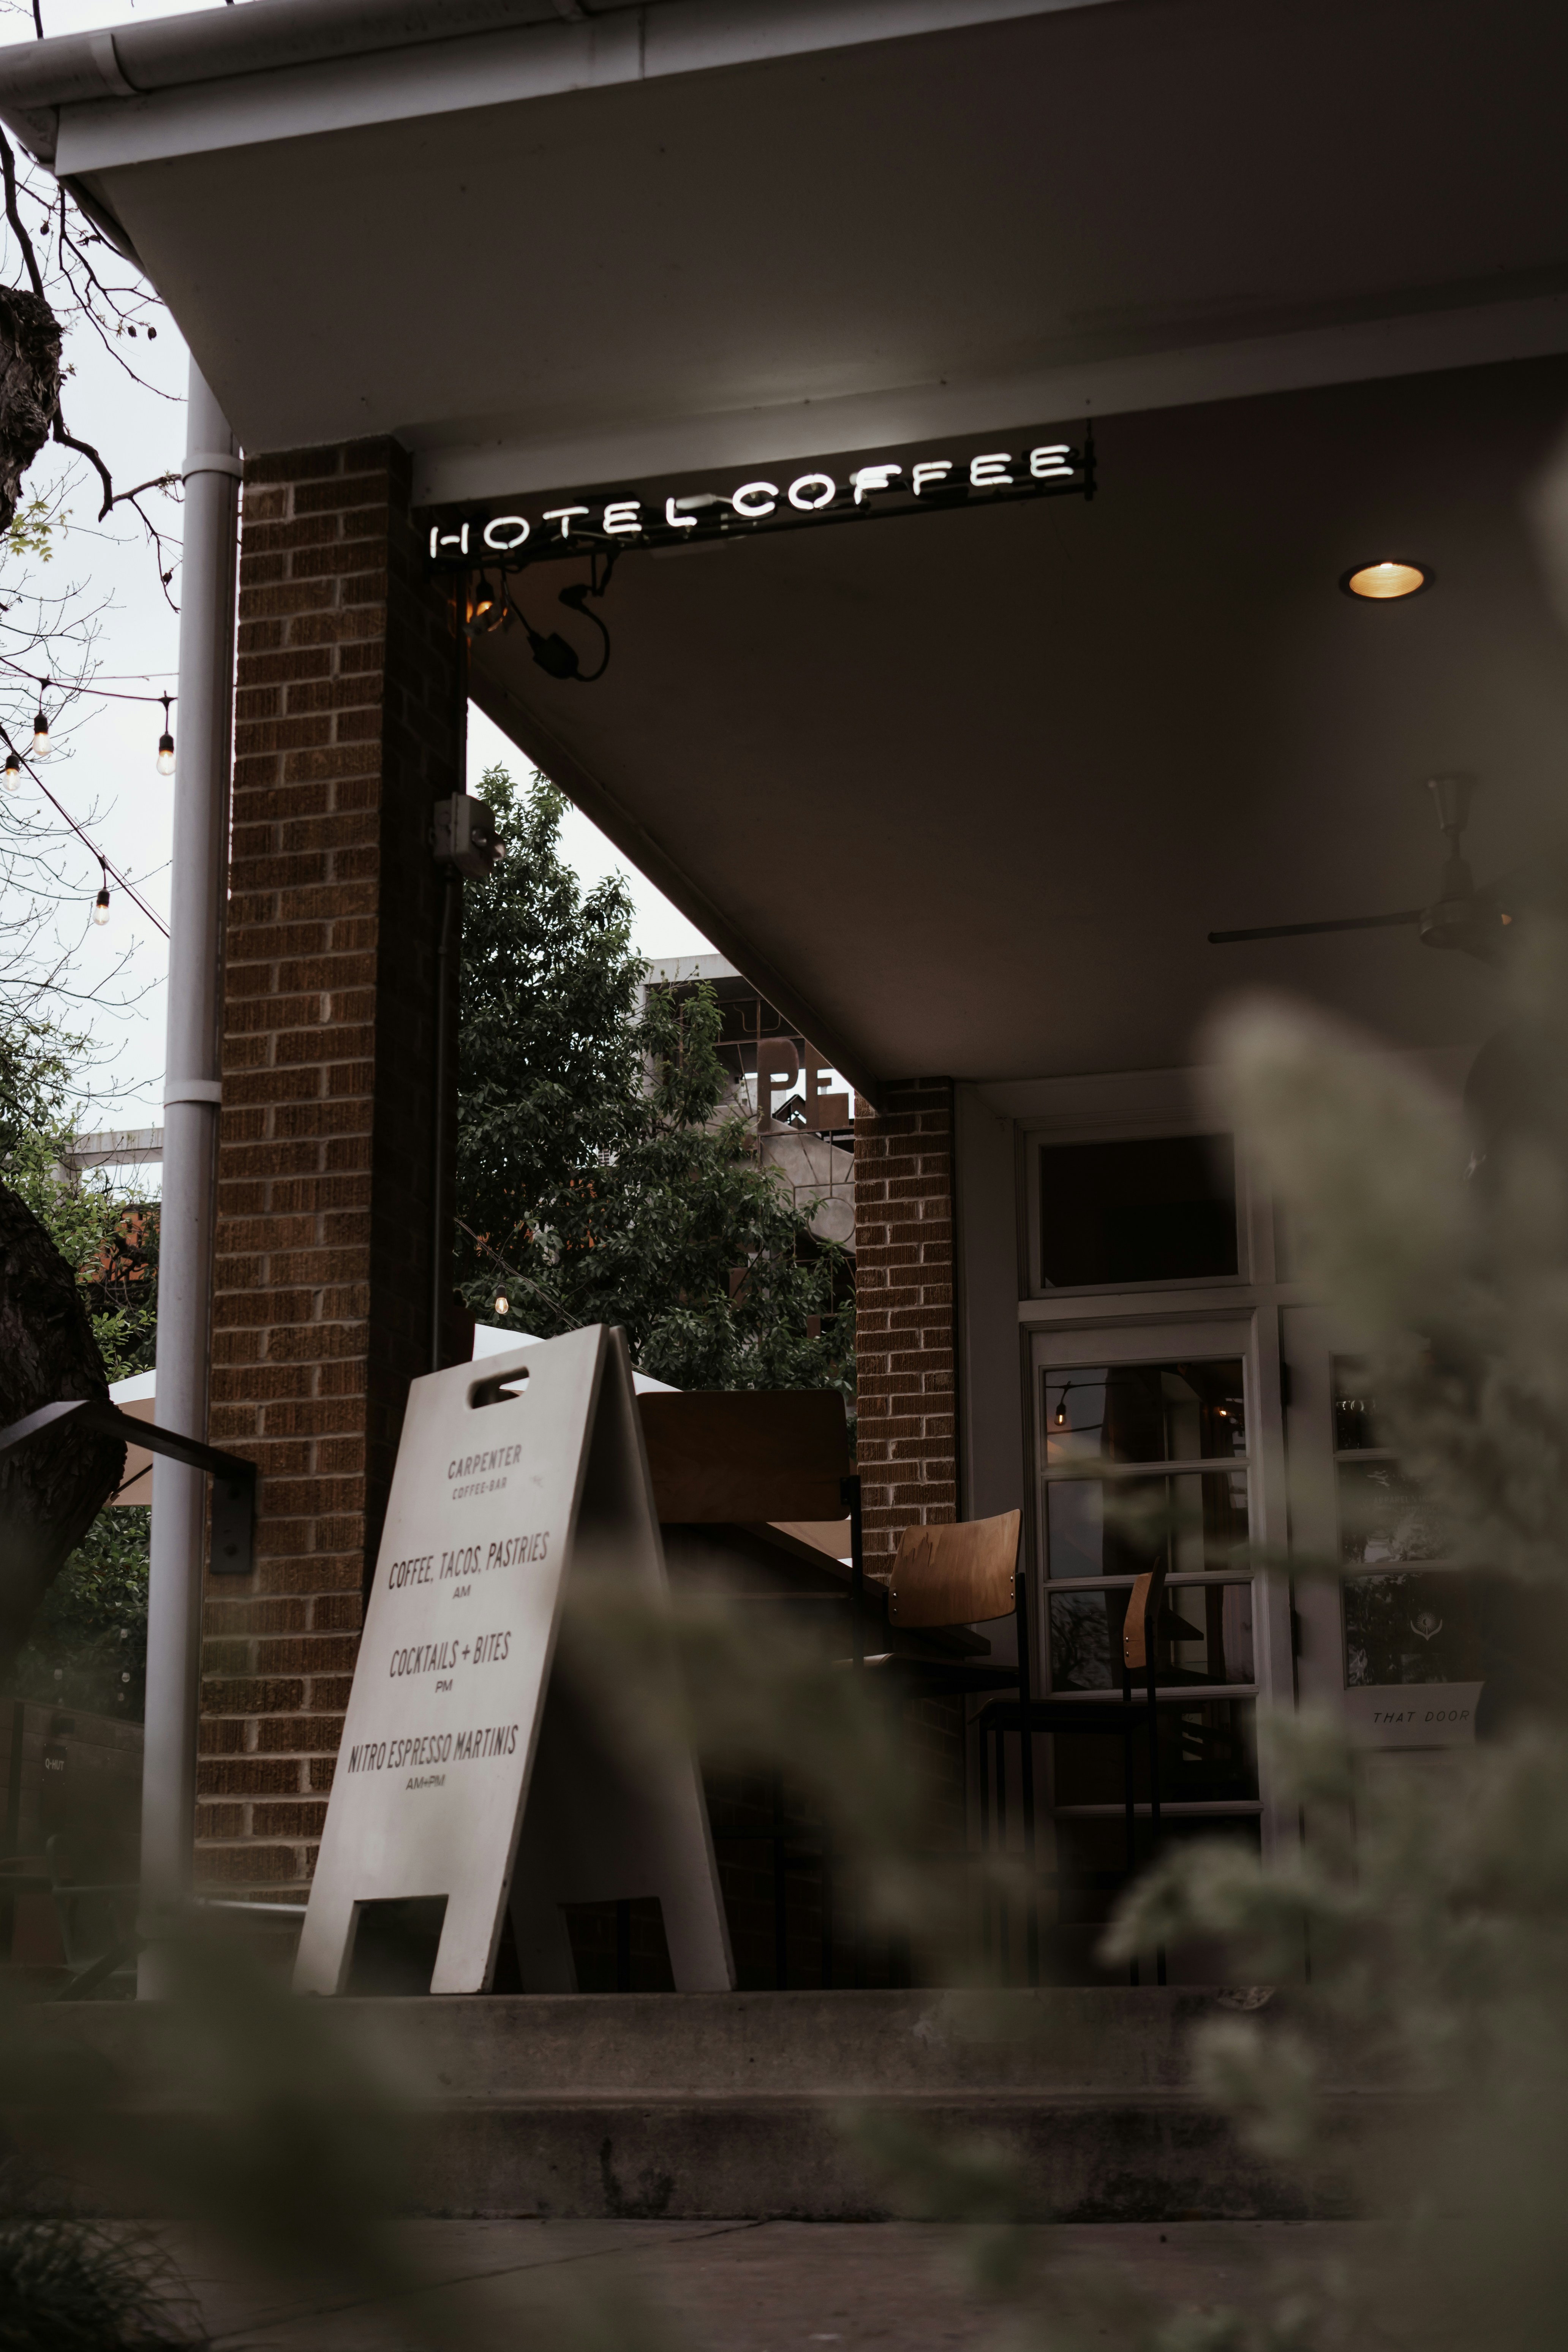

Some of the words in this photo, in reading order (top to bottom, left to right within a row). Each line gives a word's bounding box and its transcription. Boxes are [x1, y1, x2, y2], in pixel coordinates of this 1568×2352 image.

[431, 497, 697, 558] HOTEL
[732, 444, 1074, 517] COFFEE
[447, 1444, 522, 1479] CARPENTER
[389, 1555, 434, 1590] COFFEE,
[439, 1545, 481, 1580] TACOS,
[486, 1531, 550, 1571] PASTRIES
[452, 1584, 471, 1600] AM
[390, 1639, 459, 1678] COCKTAILS
[462, 1644, 470, 1660] +
[473, 1631, 511, 1664] BITES
[435, 1679, 453, 1693] PM
[1374, 1711, 1416, 1723] THAT
[1424, 1710, 1470, 1722] DOOR
[348, 1742, 386, 1773] NITRO
[387, 1733, 452, 1769] ESPRESSO
[453, 1724, 519, 1761] MARTINIS
[45, 1758, 64, 1771] Q-HUT
[406, 1774, 446, 1791] AM+PM
